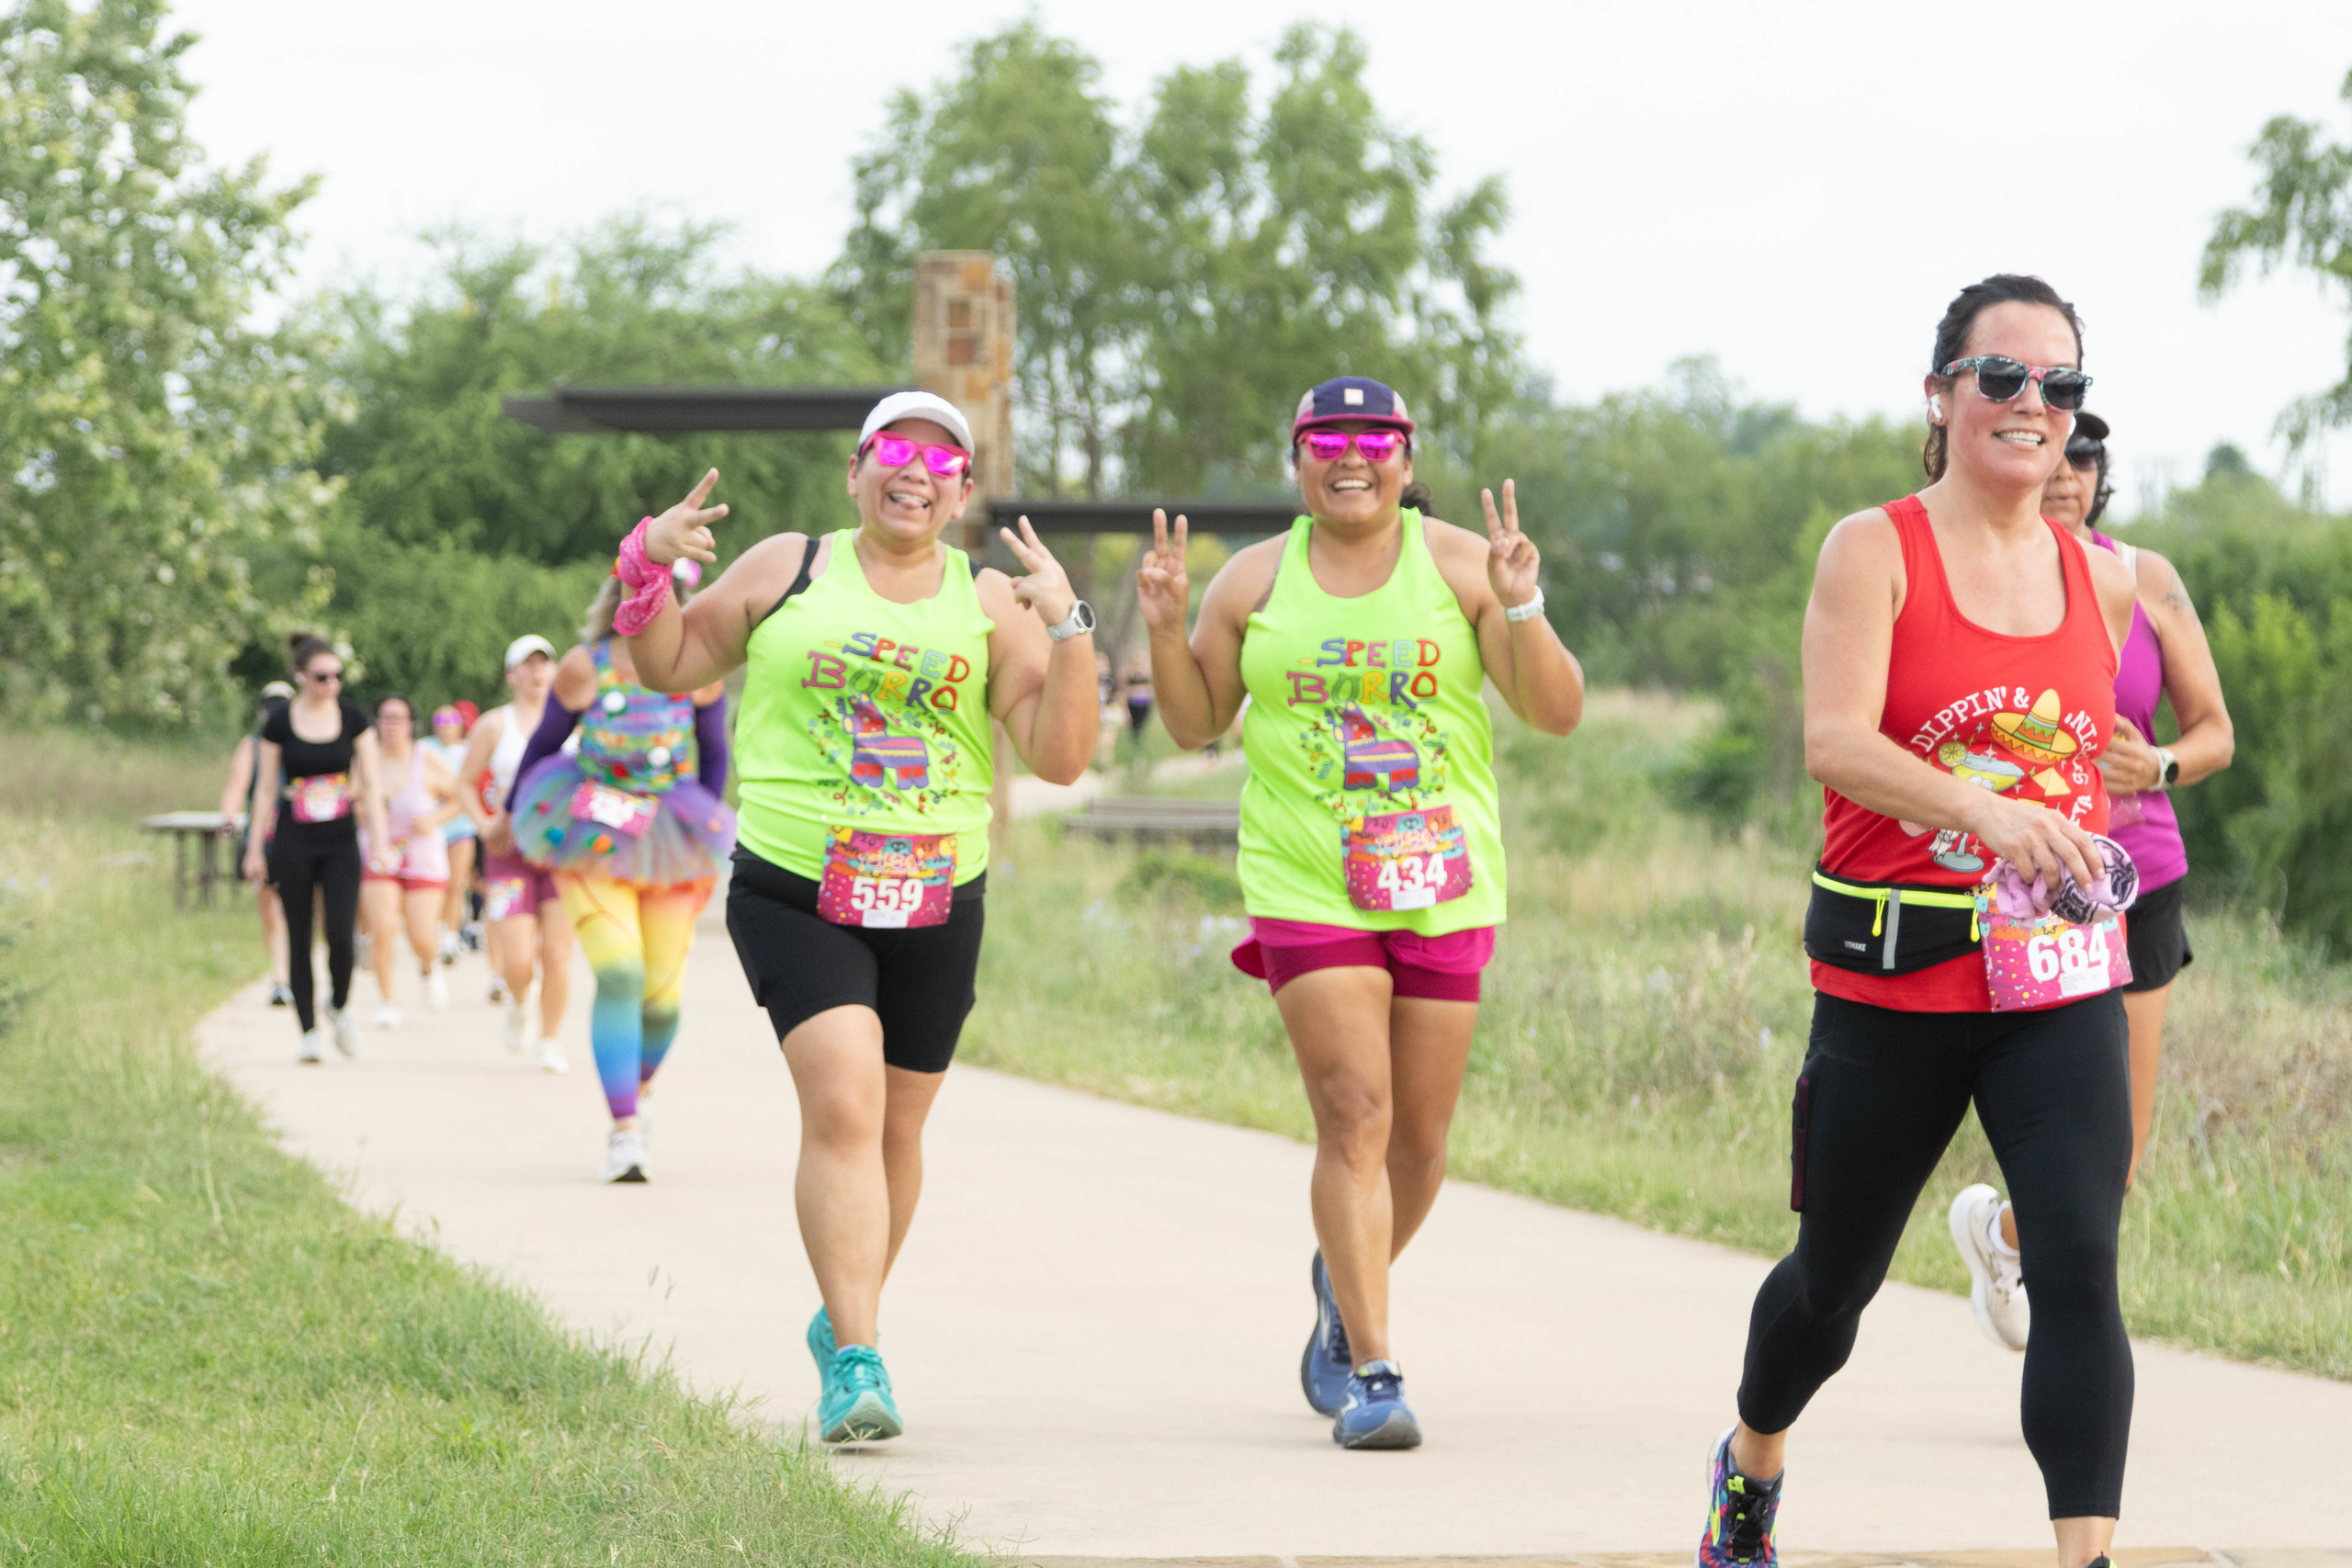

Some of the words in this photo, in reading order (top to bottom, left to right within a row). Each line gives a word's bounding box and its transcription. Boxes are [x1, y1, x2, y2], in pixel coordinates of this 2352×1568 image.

[842, 632, 970, 683] SPEED
[1317, 637, 1441, 668] SPEED
[1911, 685, 2007, 753] DIPPIN'
[2013, 686, 2030, 709] &
[851, 875, 924, 912] 559
[1378, 852, 1448, 892] 434
[2027, 922, 2110, 982] 684
